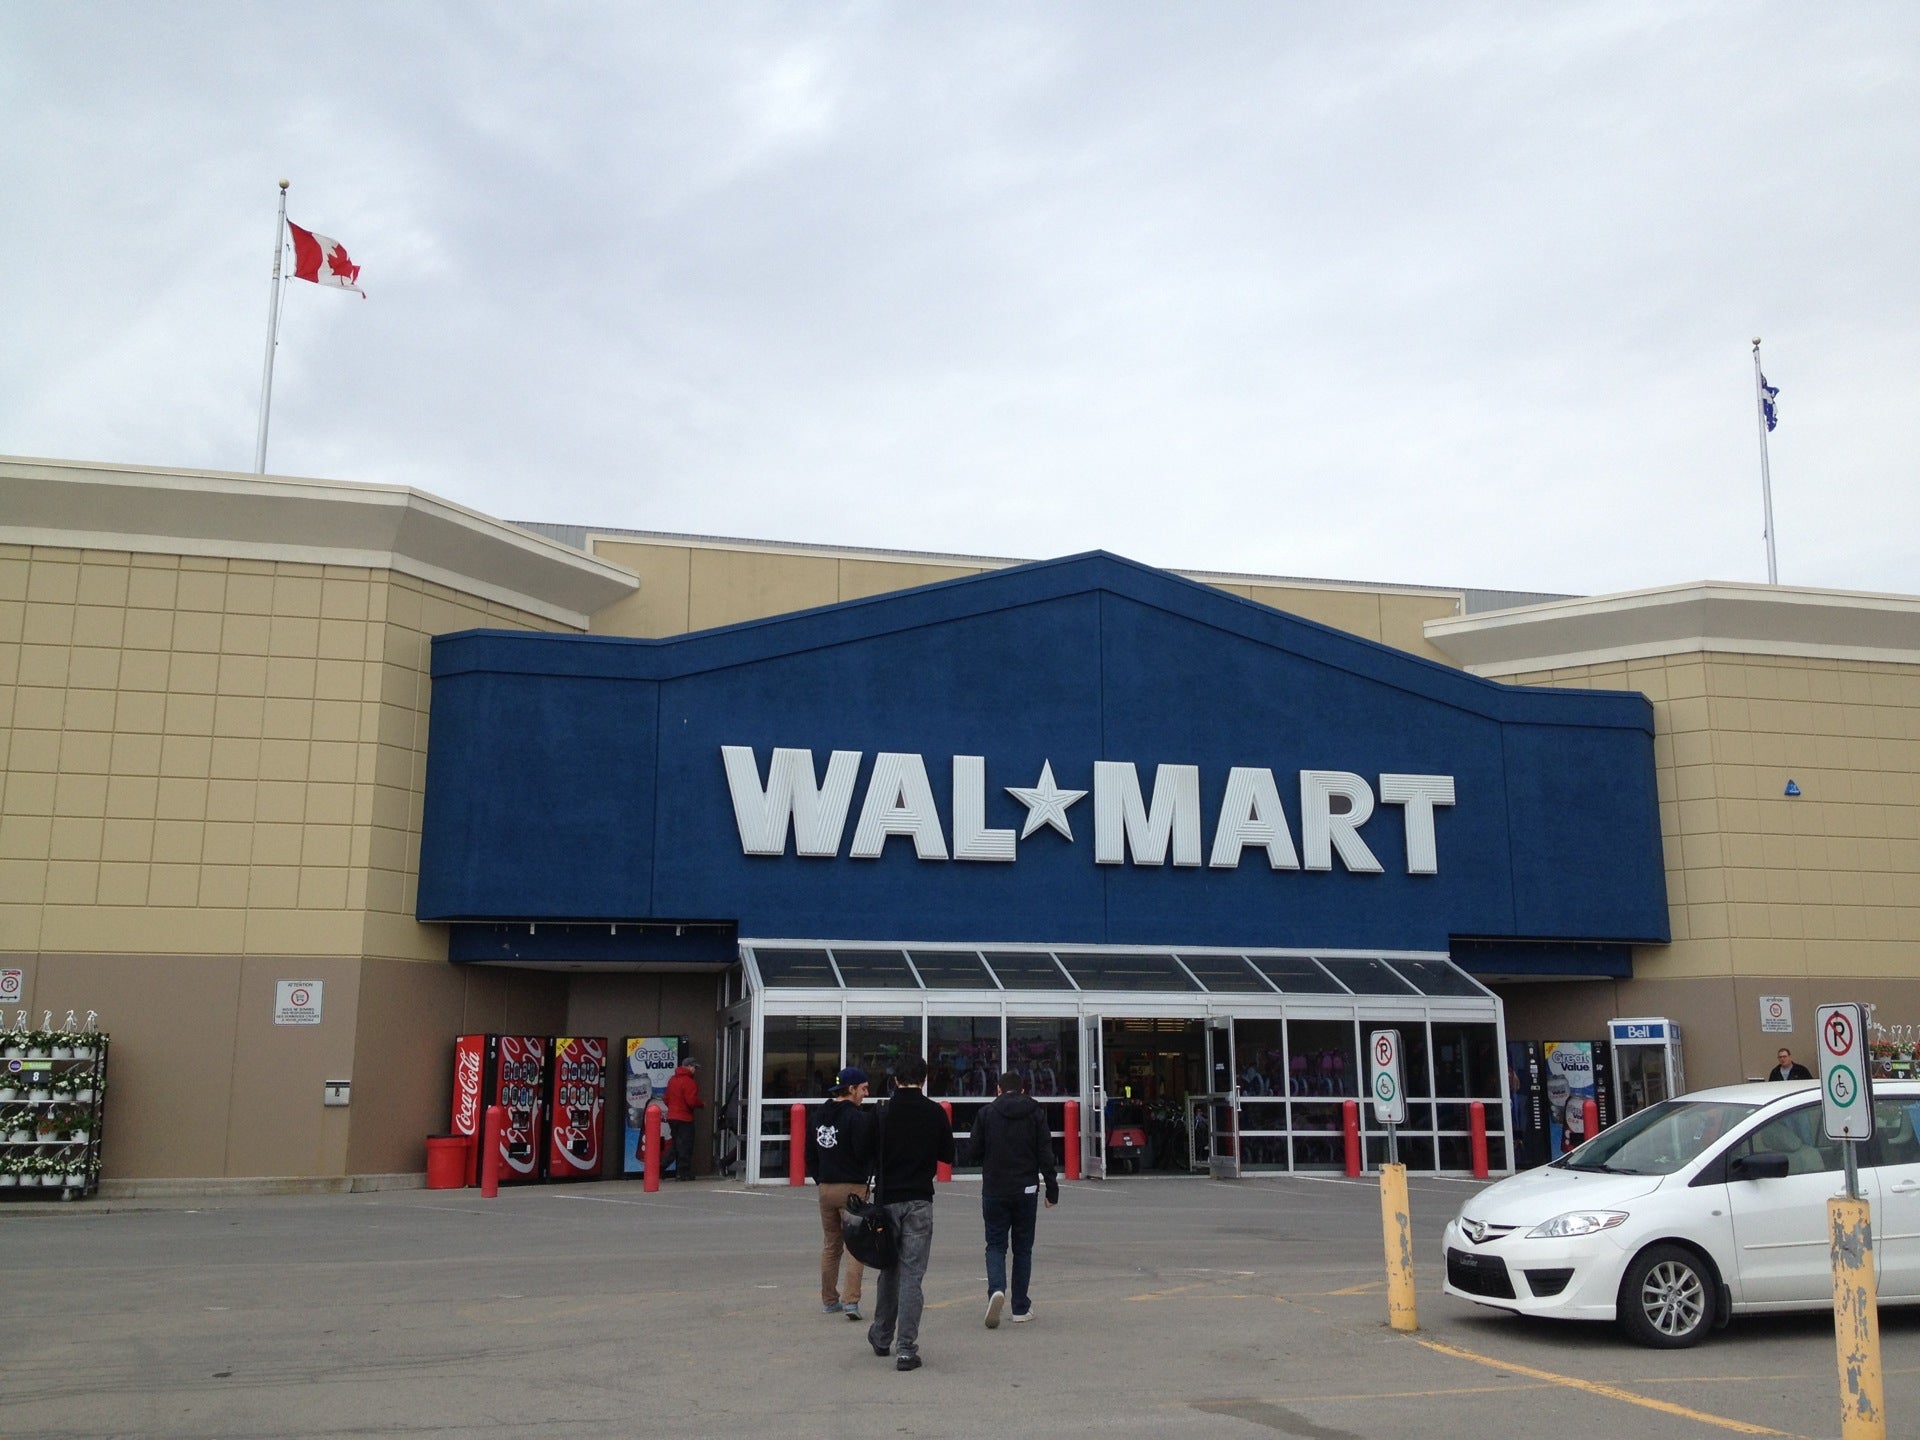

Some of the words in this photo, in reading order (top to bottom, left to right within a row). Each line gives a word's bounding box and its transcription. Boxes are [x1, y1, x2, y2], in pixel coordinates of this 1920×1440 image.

[720, 745, 1017, 862] WAL
[1093, 760, 1456, 874] MART
[1627, 1025, 1650, 1038] Bell
[635, 1047, 675, 1062] Great
[1551, 1050, 1590, 1064] Great
[644, 1060, 675, 1070] Value
[1561, 1062, 1590, 1072] Value
[32, 1071, 40, 1082] 8
[455, 1046, 480, 1136] Coca-Cola
